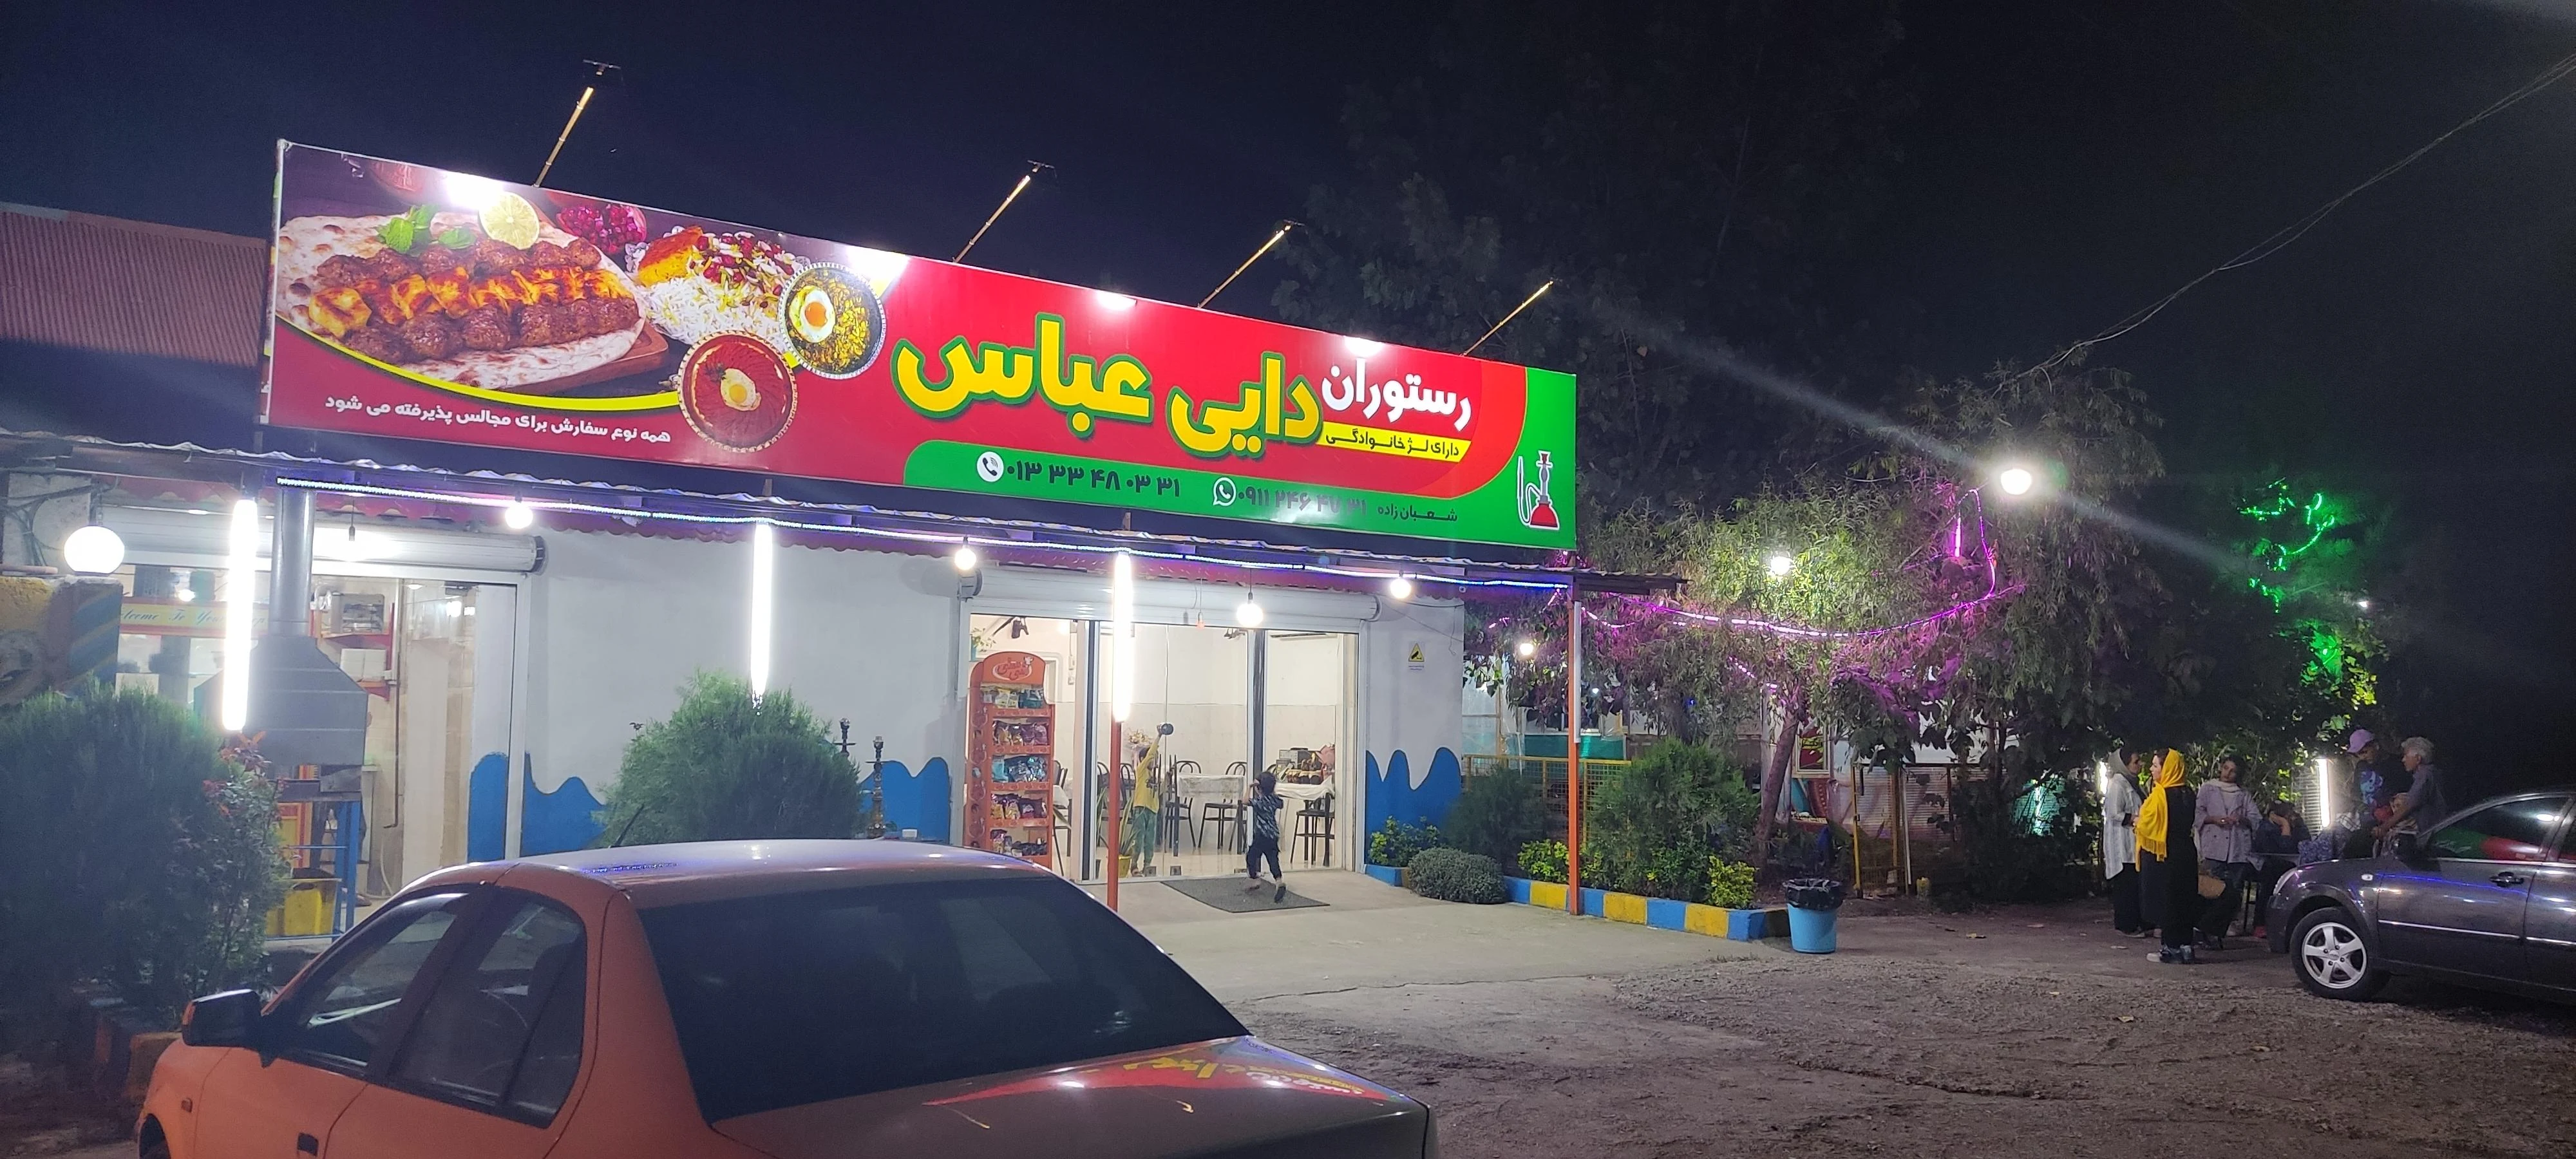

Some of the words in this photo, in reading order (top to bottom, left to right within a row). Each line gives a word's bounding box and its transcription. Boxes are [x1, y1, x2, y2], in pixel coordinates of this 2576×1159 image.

[894, 316, 1152, 435] عباس
[1321, 357, 1472, 431] رستوران
[325, 395, 363, 412] شود
[366, 403, 391, 416] می
[1168, 354, 1322, 456] دایی
[394, 403, 452, 425] پذیرفته
[456, 410, 511, 427] مجالس
[515, 415, 547, 433] برای
[551, 419, 608, 437] سفارش
[611, 428, 637, 442] نوع
[641, 430, 670, 442] همه
[1430, 441, 1459, 459] دارای
